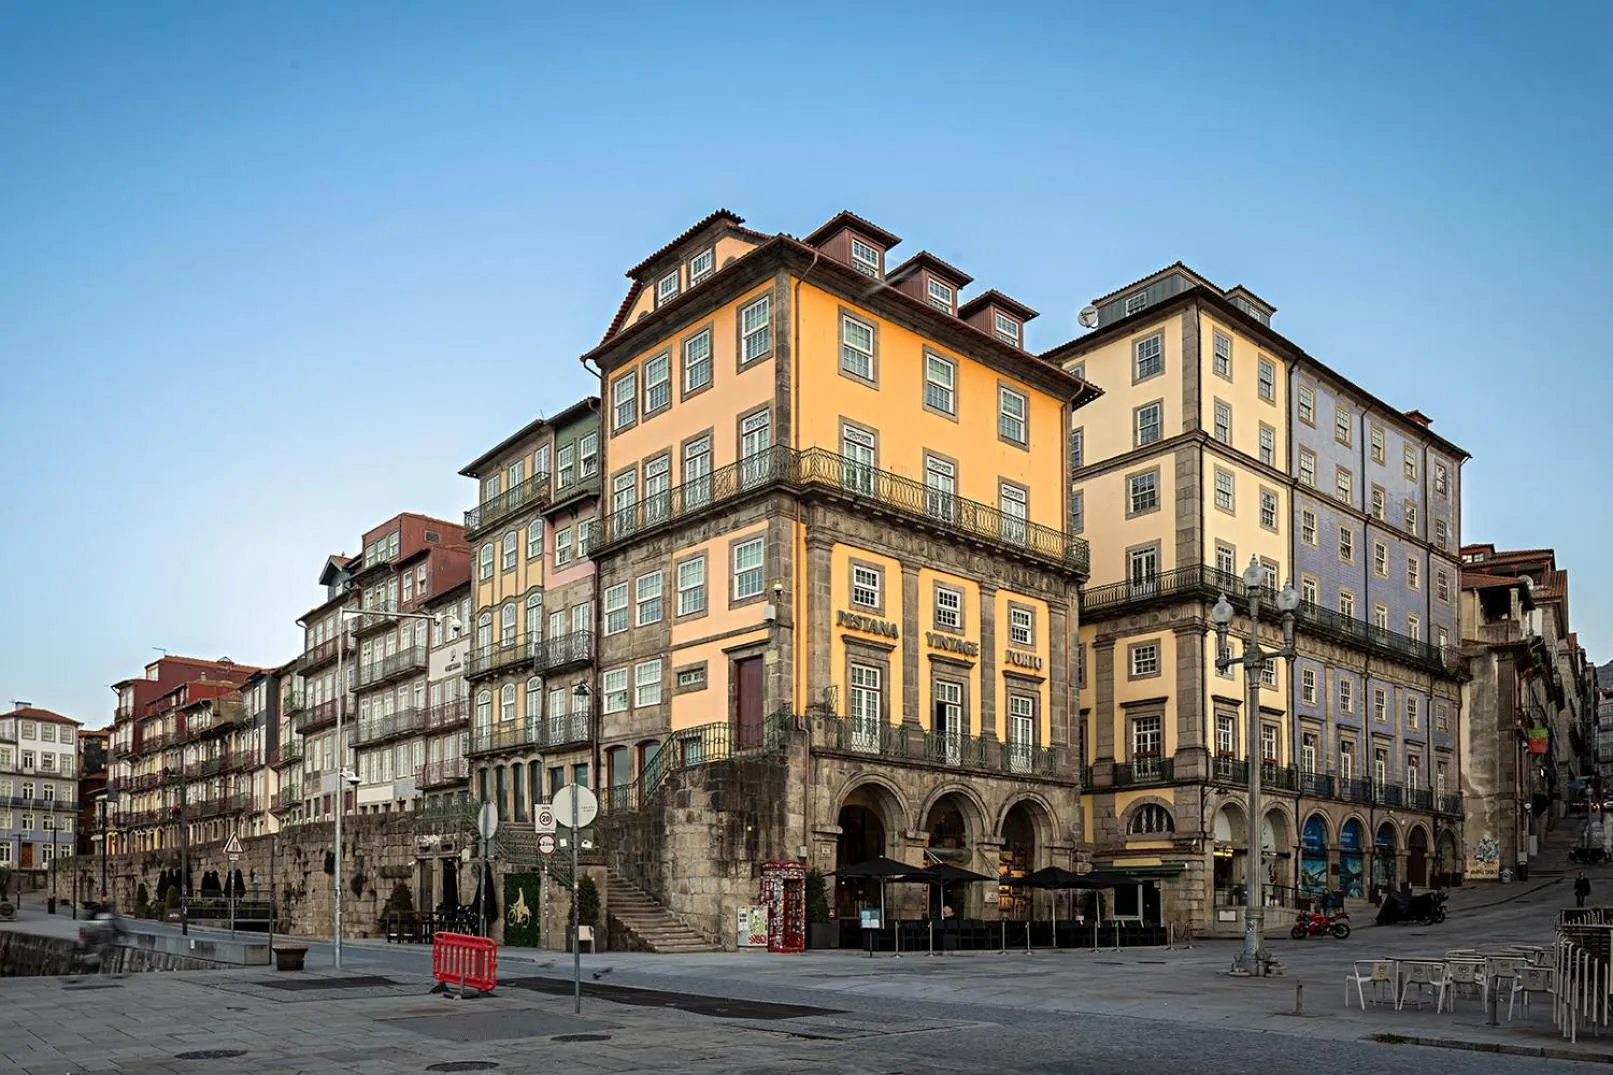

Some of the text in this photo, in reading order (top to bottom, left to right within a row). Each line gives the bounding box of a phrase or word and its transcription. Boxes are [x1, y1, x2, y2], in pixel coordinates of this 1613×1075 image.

[836, 610, 1042, 671] PESTANA VINTAGE PORTO
